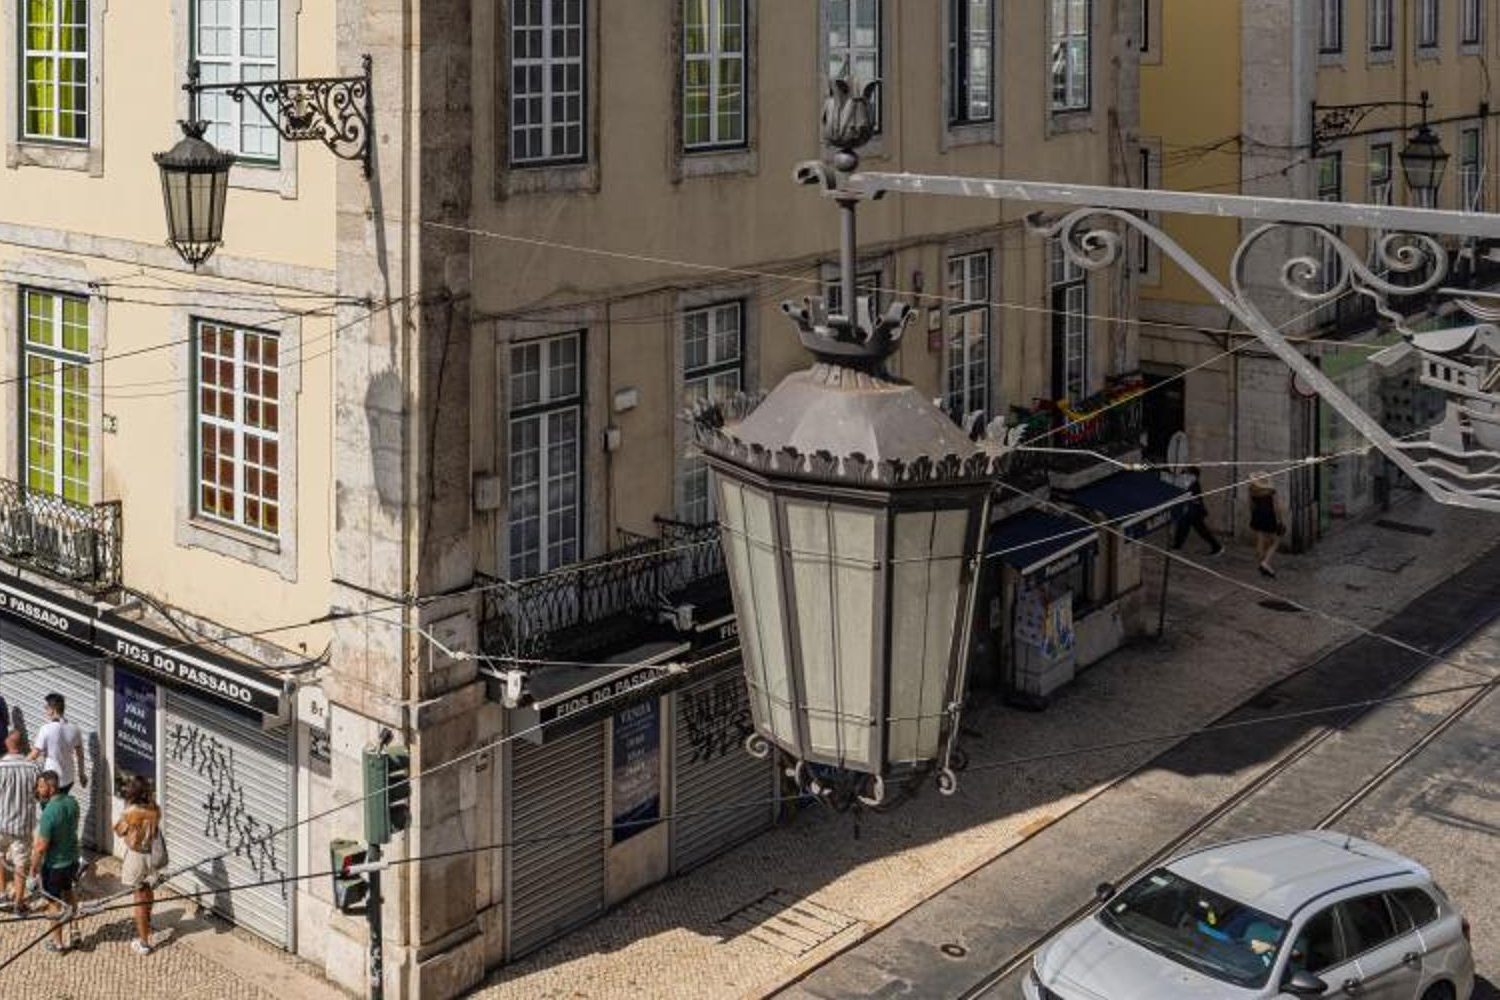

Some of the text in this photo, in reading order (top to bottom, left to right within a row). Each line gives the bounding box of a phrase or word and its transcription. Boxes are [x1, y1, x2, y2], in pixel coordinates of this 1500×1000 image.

[10, 595, 69, 631] PASSADO
[720, 622, 739, 639] FIO
[116, 640, 252, 702] FIOS DO PASSADO
[556, 696, 589, 718] FIOS
[592, 685, 612, 703] DO
